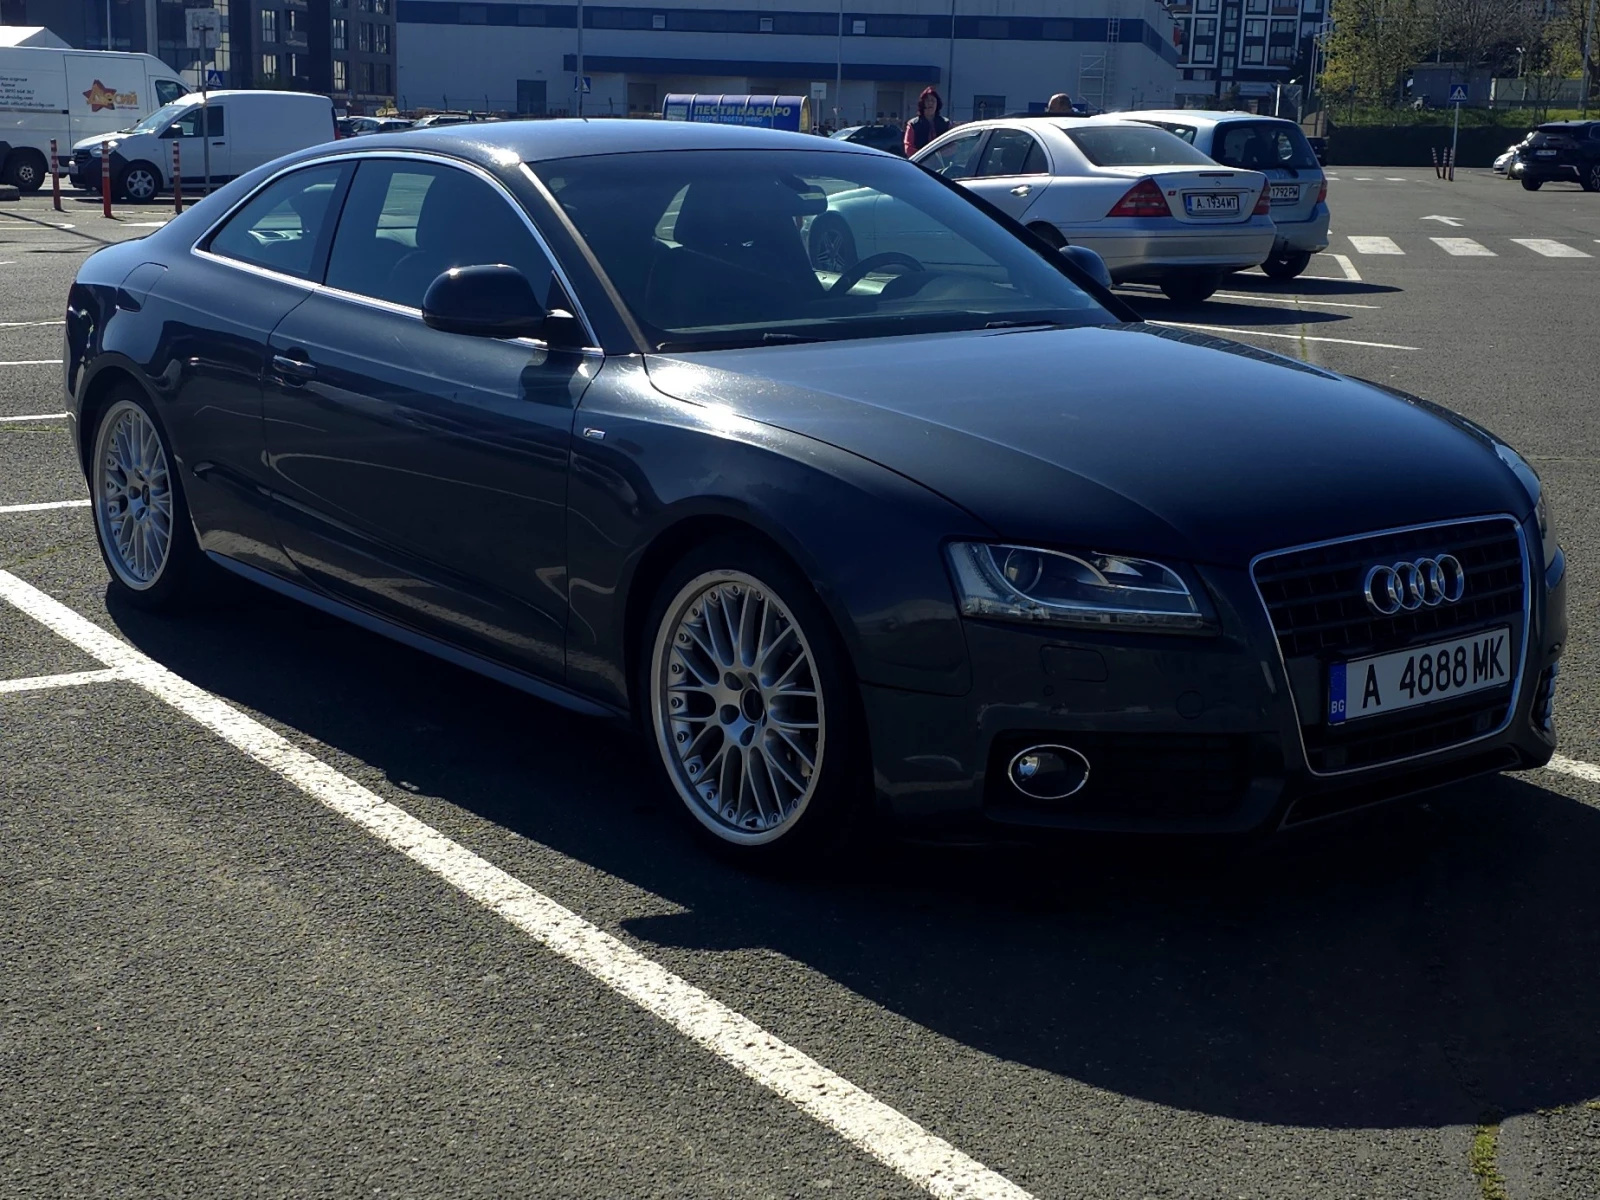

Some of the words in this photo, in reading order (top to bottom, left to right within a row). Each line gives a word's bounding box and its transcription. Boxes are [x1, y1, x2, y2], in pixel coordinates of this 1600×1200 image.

[694, 105, 735, 116] ПЕСТИ
[736, 106, 756, 116] НА
[756, 106, 791, 117] ЕДРО
[1362, 664, 1381, 709] A
[1400, 645, 1467, 699] 4888
[1473, 635, 1504, 684] MK
[1331, 699, 1345, 714] BG
